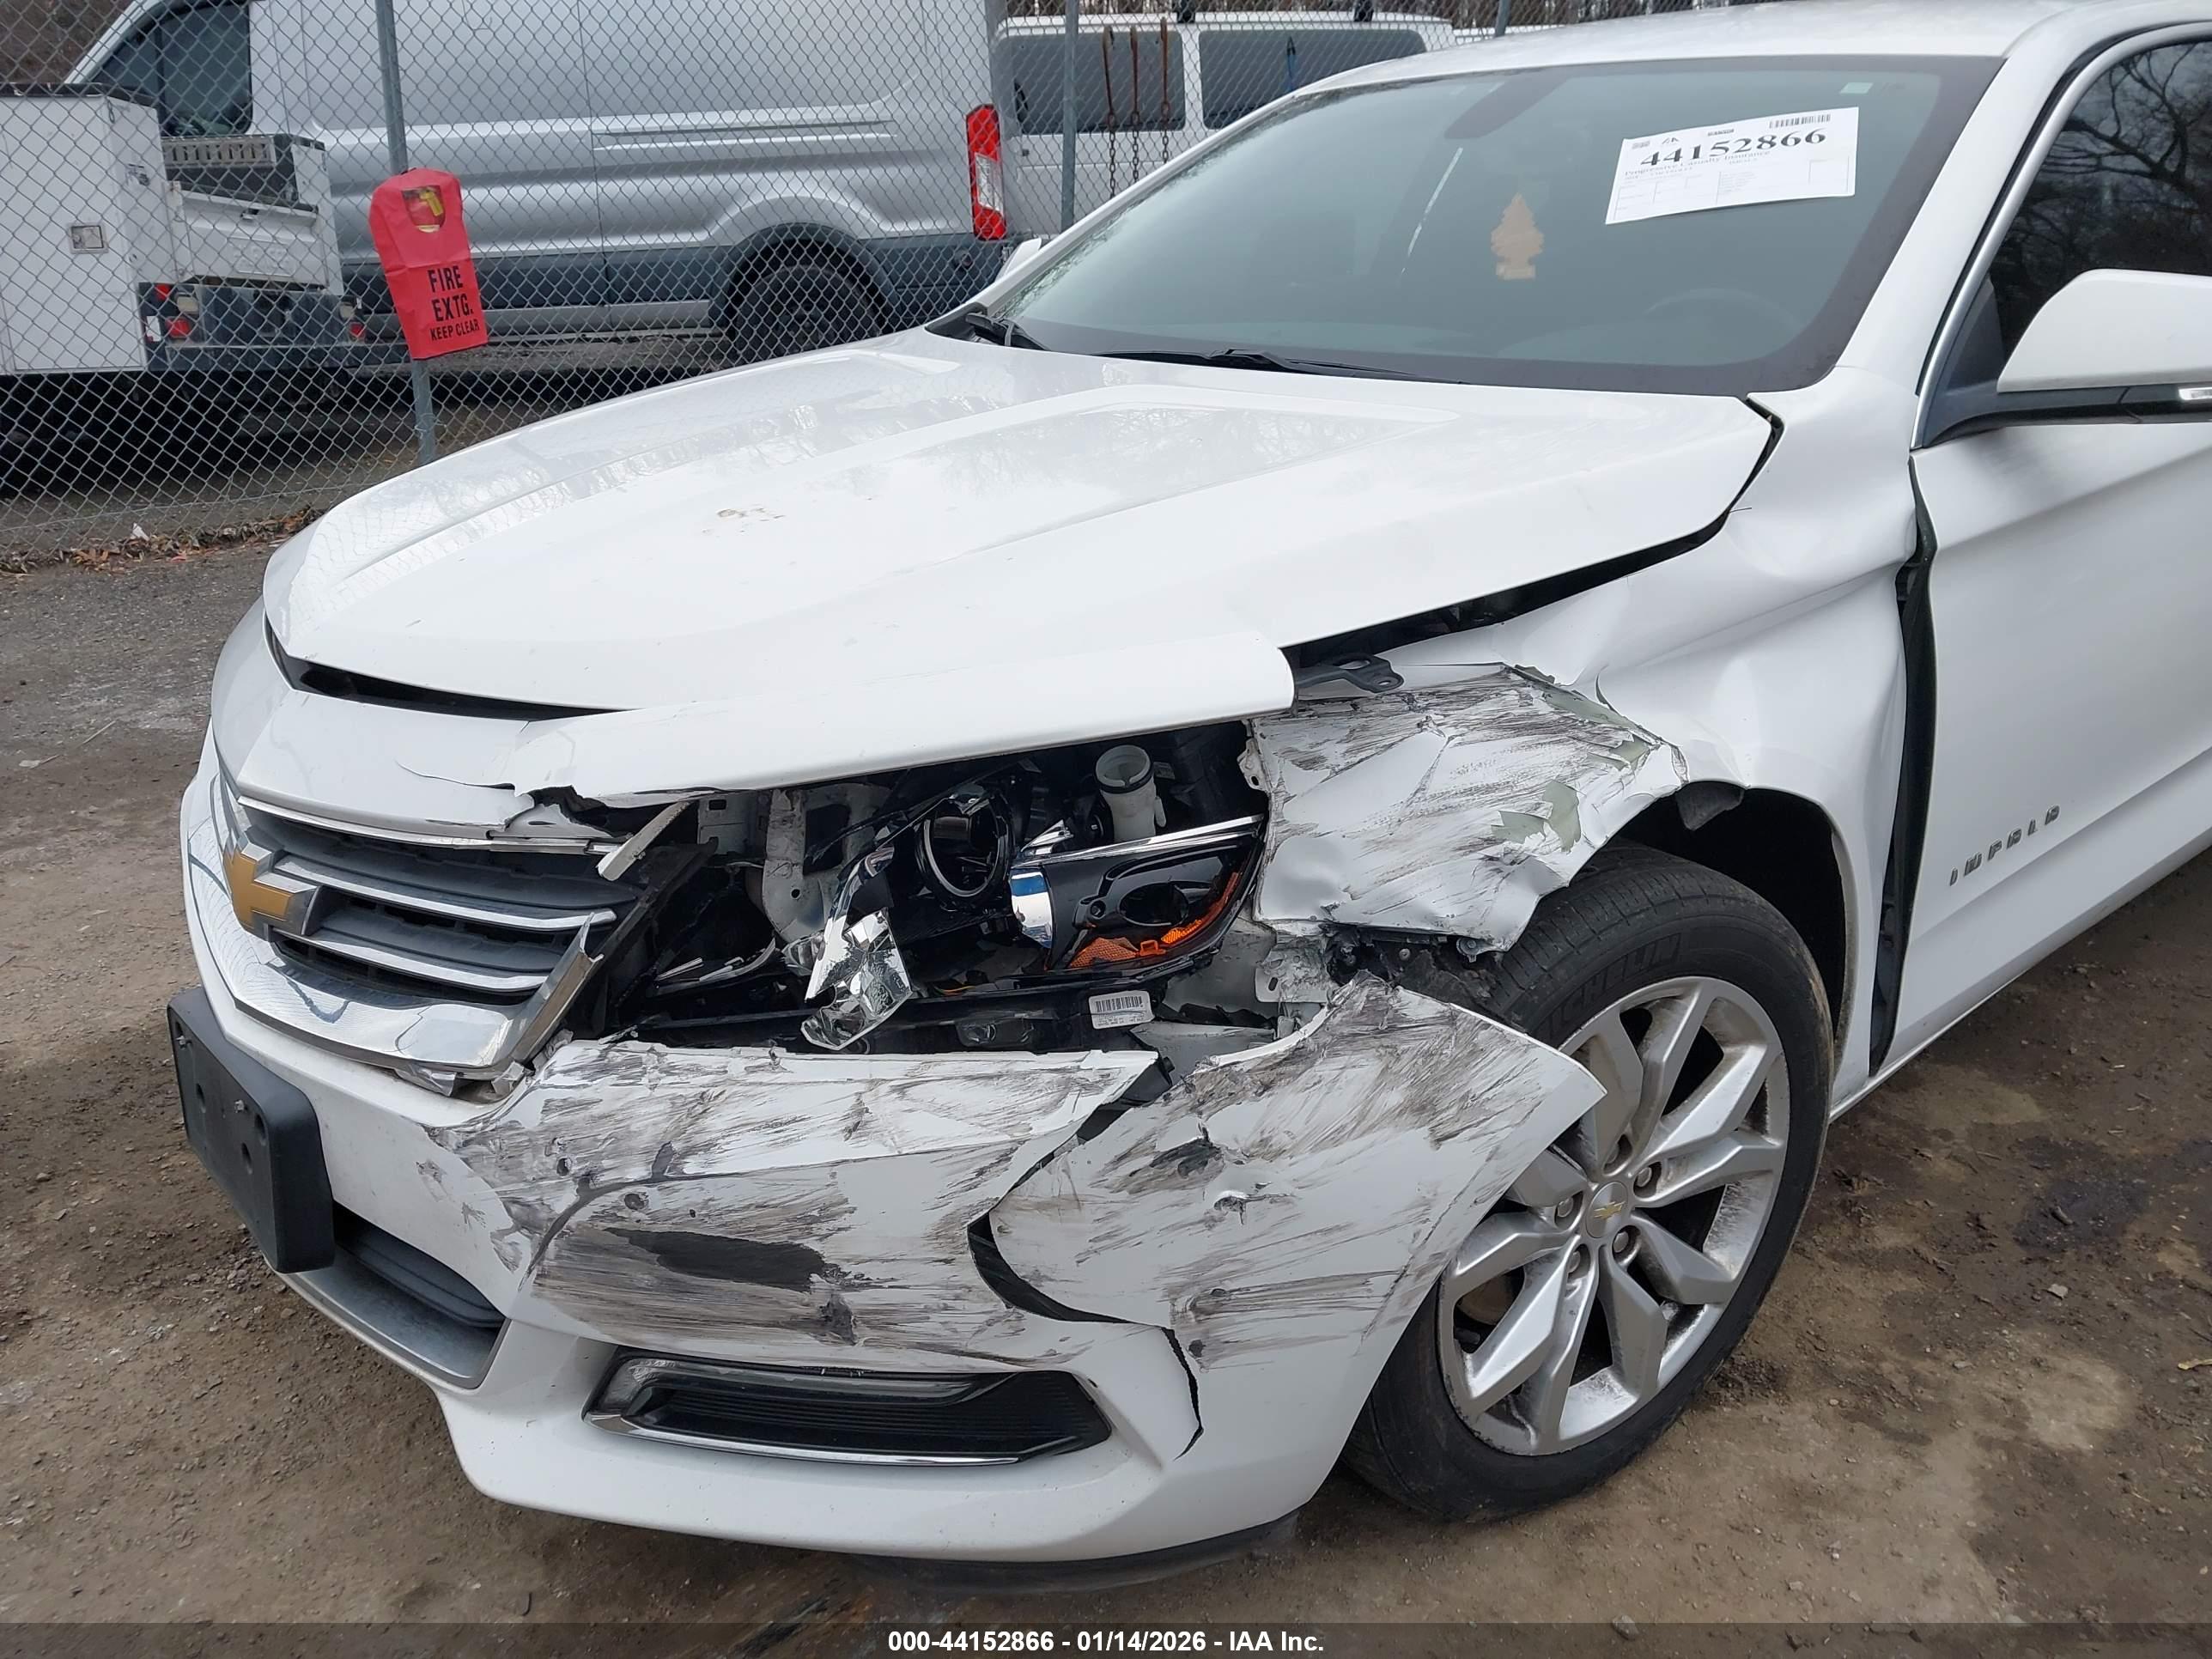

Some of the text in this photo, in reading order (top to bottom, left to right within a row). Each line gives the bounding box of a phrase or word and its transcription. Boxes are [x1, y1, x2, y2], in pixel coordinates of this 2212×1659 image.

[1640, 128, 1826, 166] 44152866
[428, 265, 464, 293] FIRE
[431, 293, 474, 322] EXTG.
[430, 319, 480, 341] KEEP CLEAR
[1949, 805, 2060, 887] IMPALA
